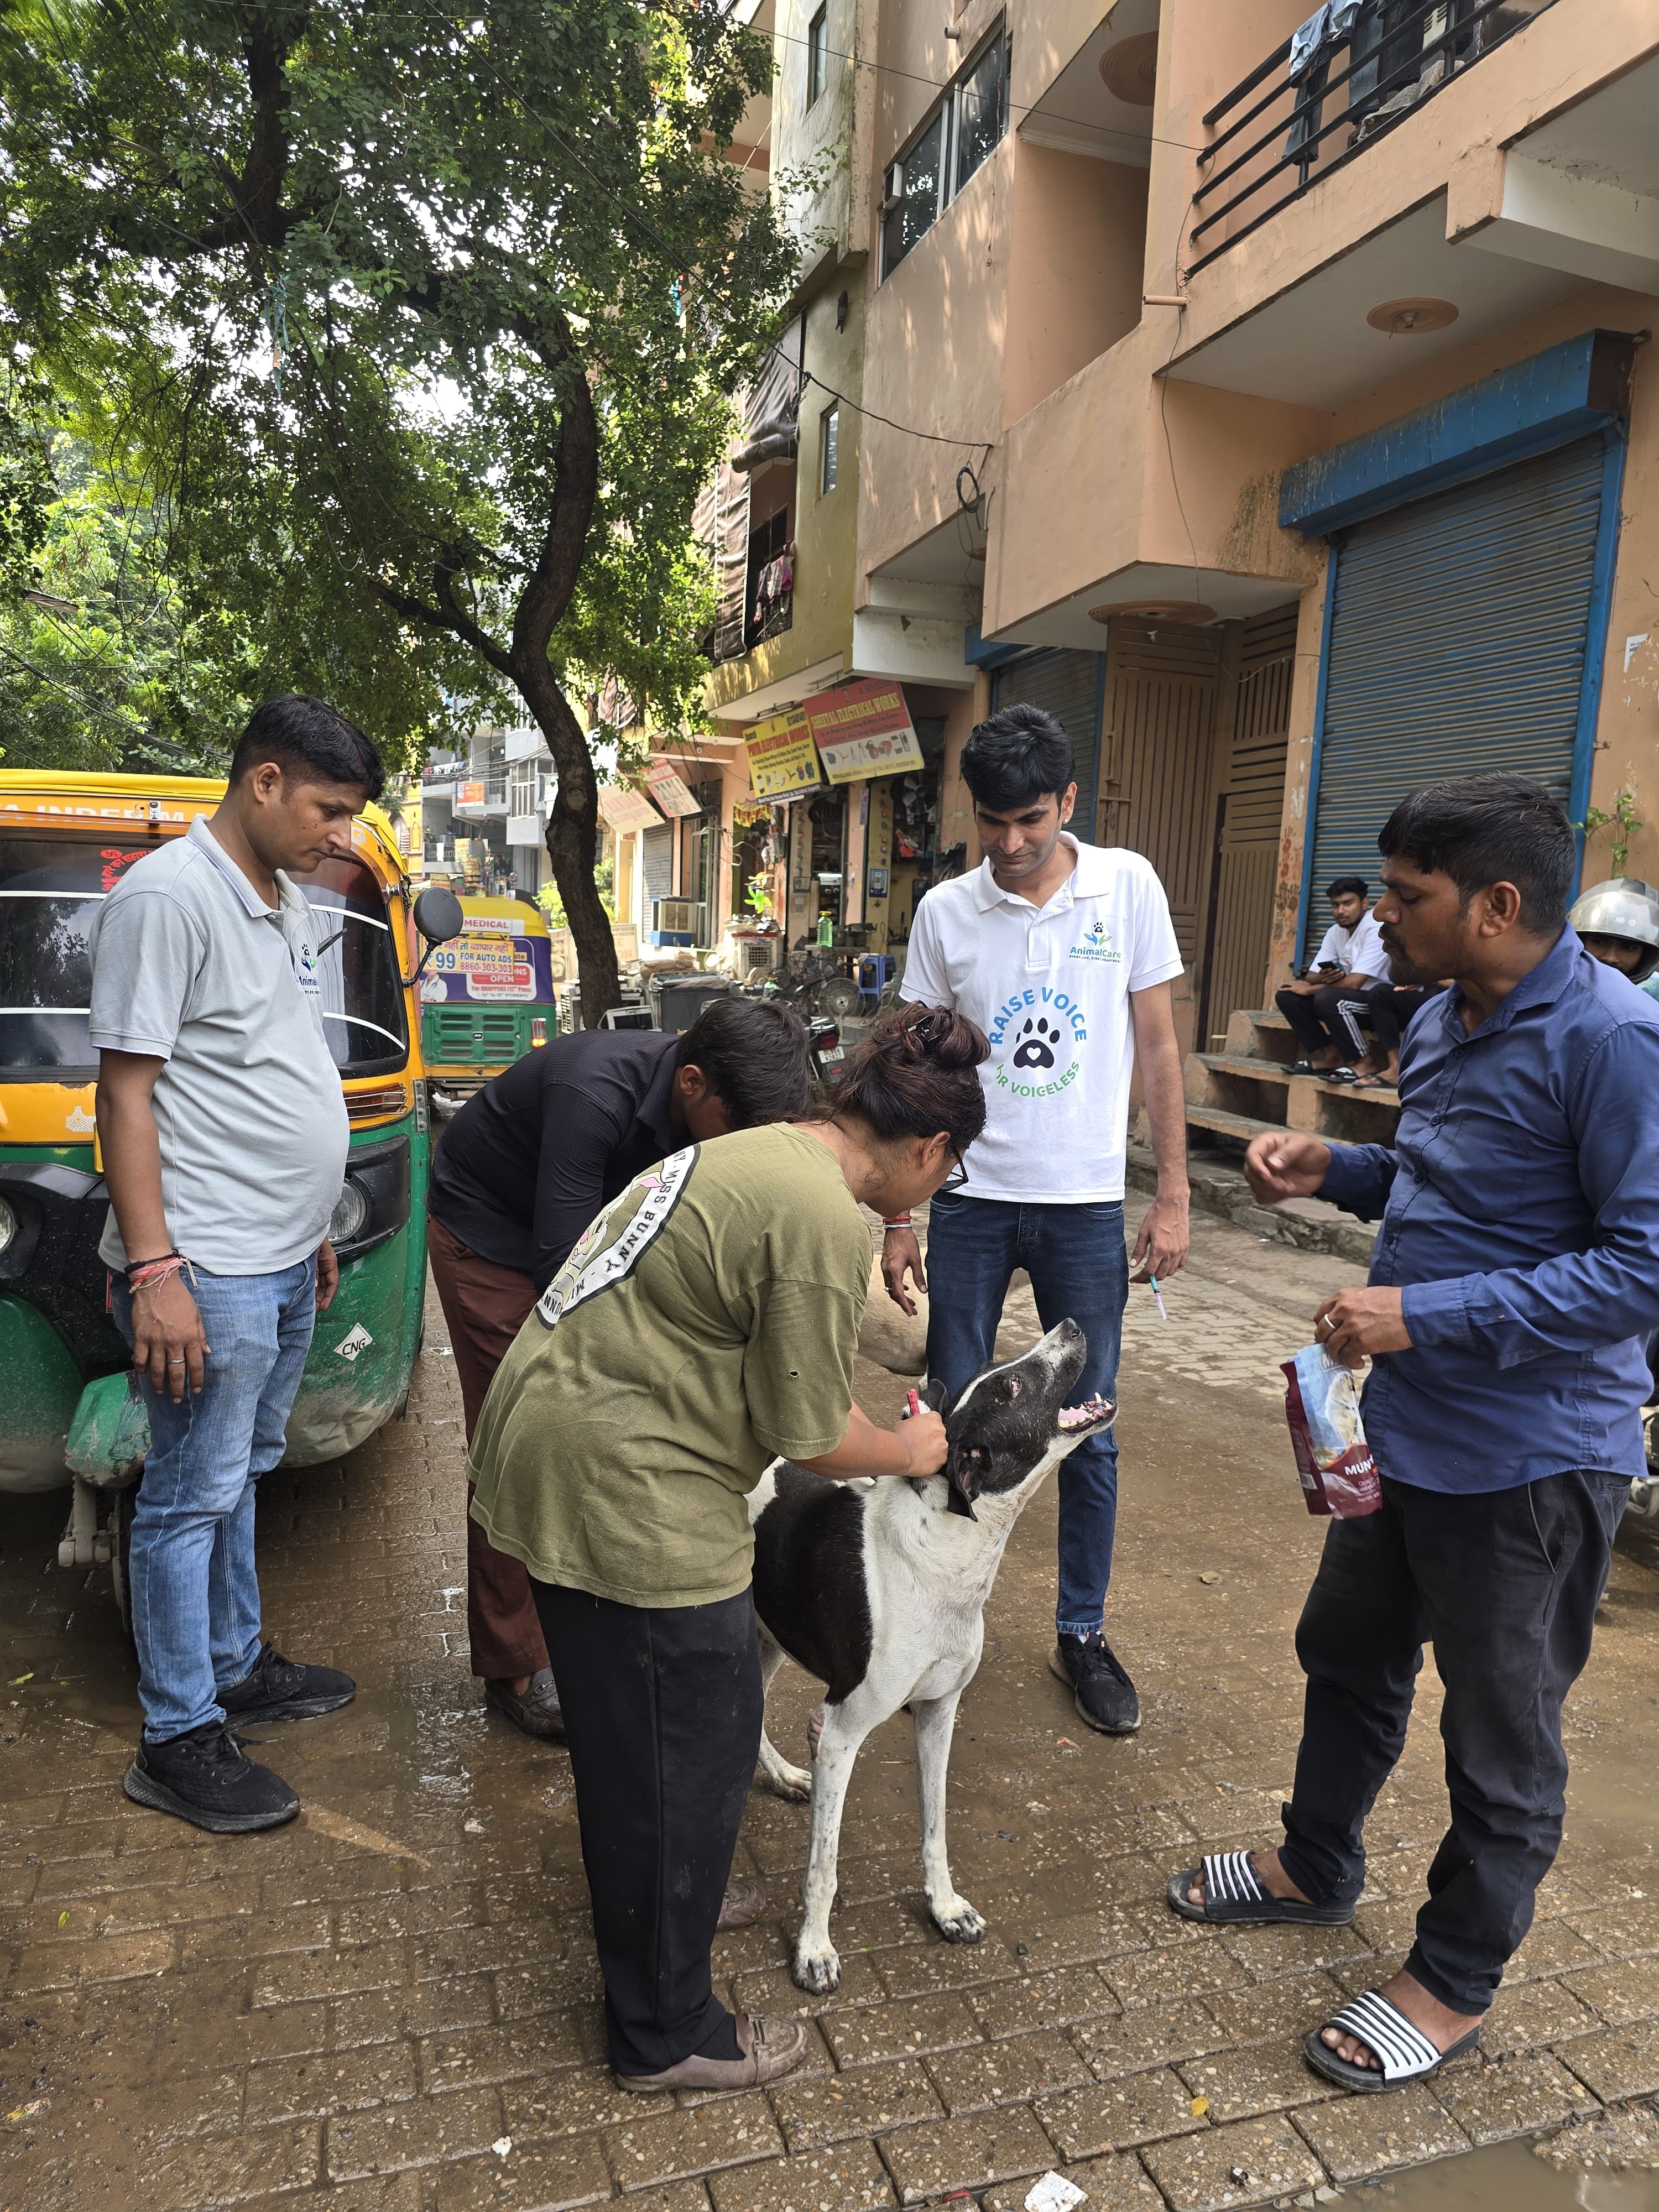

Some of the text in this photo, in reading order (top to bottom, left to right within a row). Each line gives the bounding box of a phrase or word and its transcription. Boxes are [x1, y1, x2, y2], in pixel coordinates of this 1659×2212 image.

[465, 920, 509, 928] MEDICAL
[460, 941, 468, 950] तो
[471, 943, 493, 952] व्यापार
[1070, 946, 1121, 958] AnimalCare
[460, 962, 512, 973] 8860-303-303
[989, 987, 1087, 1045] RAISE VOICE
[1011, 1061, 1079, 1098] VOICELESS
[654, 1168, 681, 1204] MISS
[605, 1209, 658, 1273] BUNNY
[342, 1338, 366, 1355] CNG
